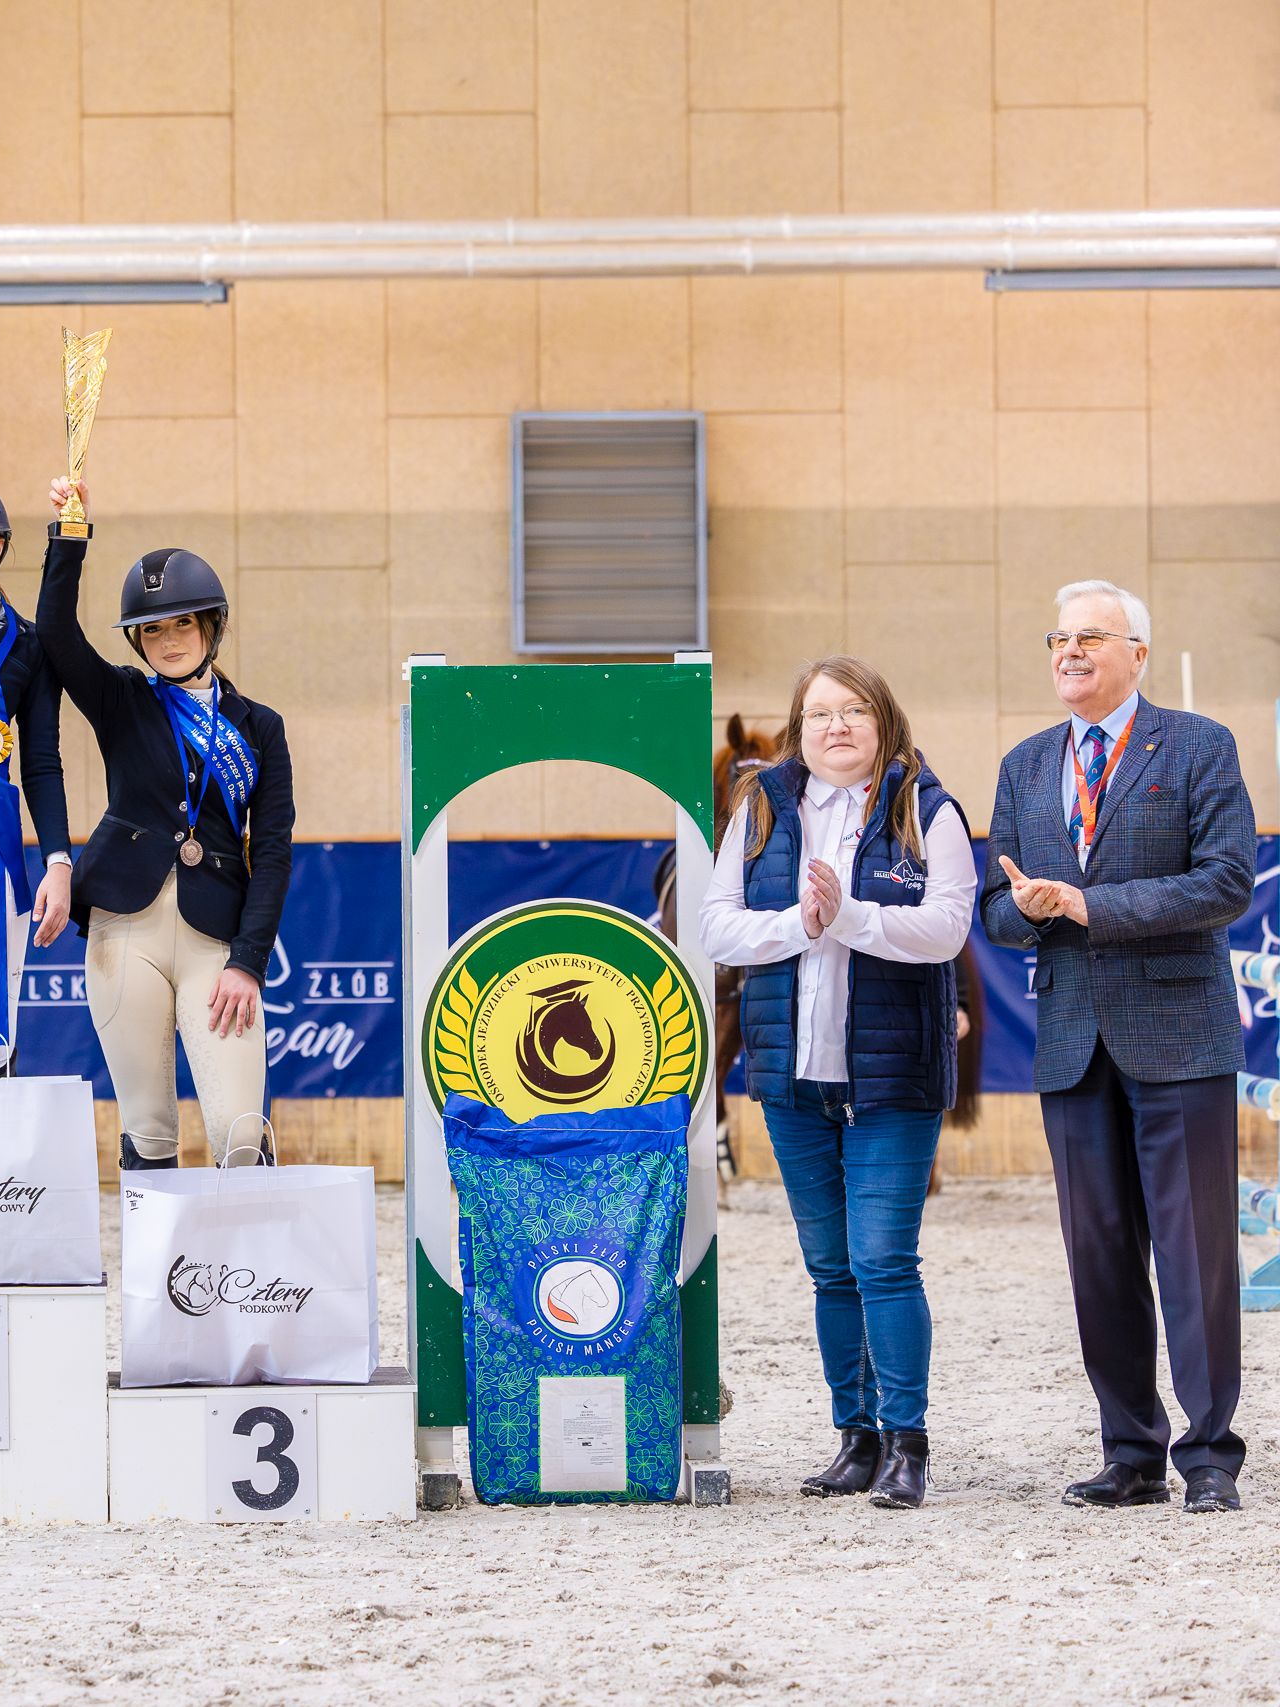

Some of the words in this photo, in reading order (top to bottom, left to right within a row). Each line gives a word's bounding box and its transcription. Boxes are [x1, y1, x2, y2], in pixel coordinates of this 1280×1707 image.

[224, 753, 241, 779] przez
[308, 968, 389, 998] ŻŁÓB
[526, 957, 626, 989] UNIWERSYTETU
[476, 974, 522, 1042] JEŹDZIECKI
[266, 1020, 366, 1071] eam
[624, 988, 654, 1104] PRZYRODNICZEGO
[476, 1045, 505, 1103] OŚRODEK
[589, 1243, 627, 1269] ŻŁÓB
[217, 1266, 314, 1313] Cztery
[239, 1304, 293, 1314] PODKOWY
[526, 1318, 574, 1356] POLISH
[583, 1318, 636, 1356] MANGER
[231, 1406, 300, 1511] 3
